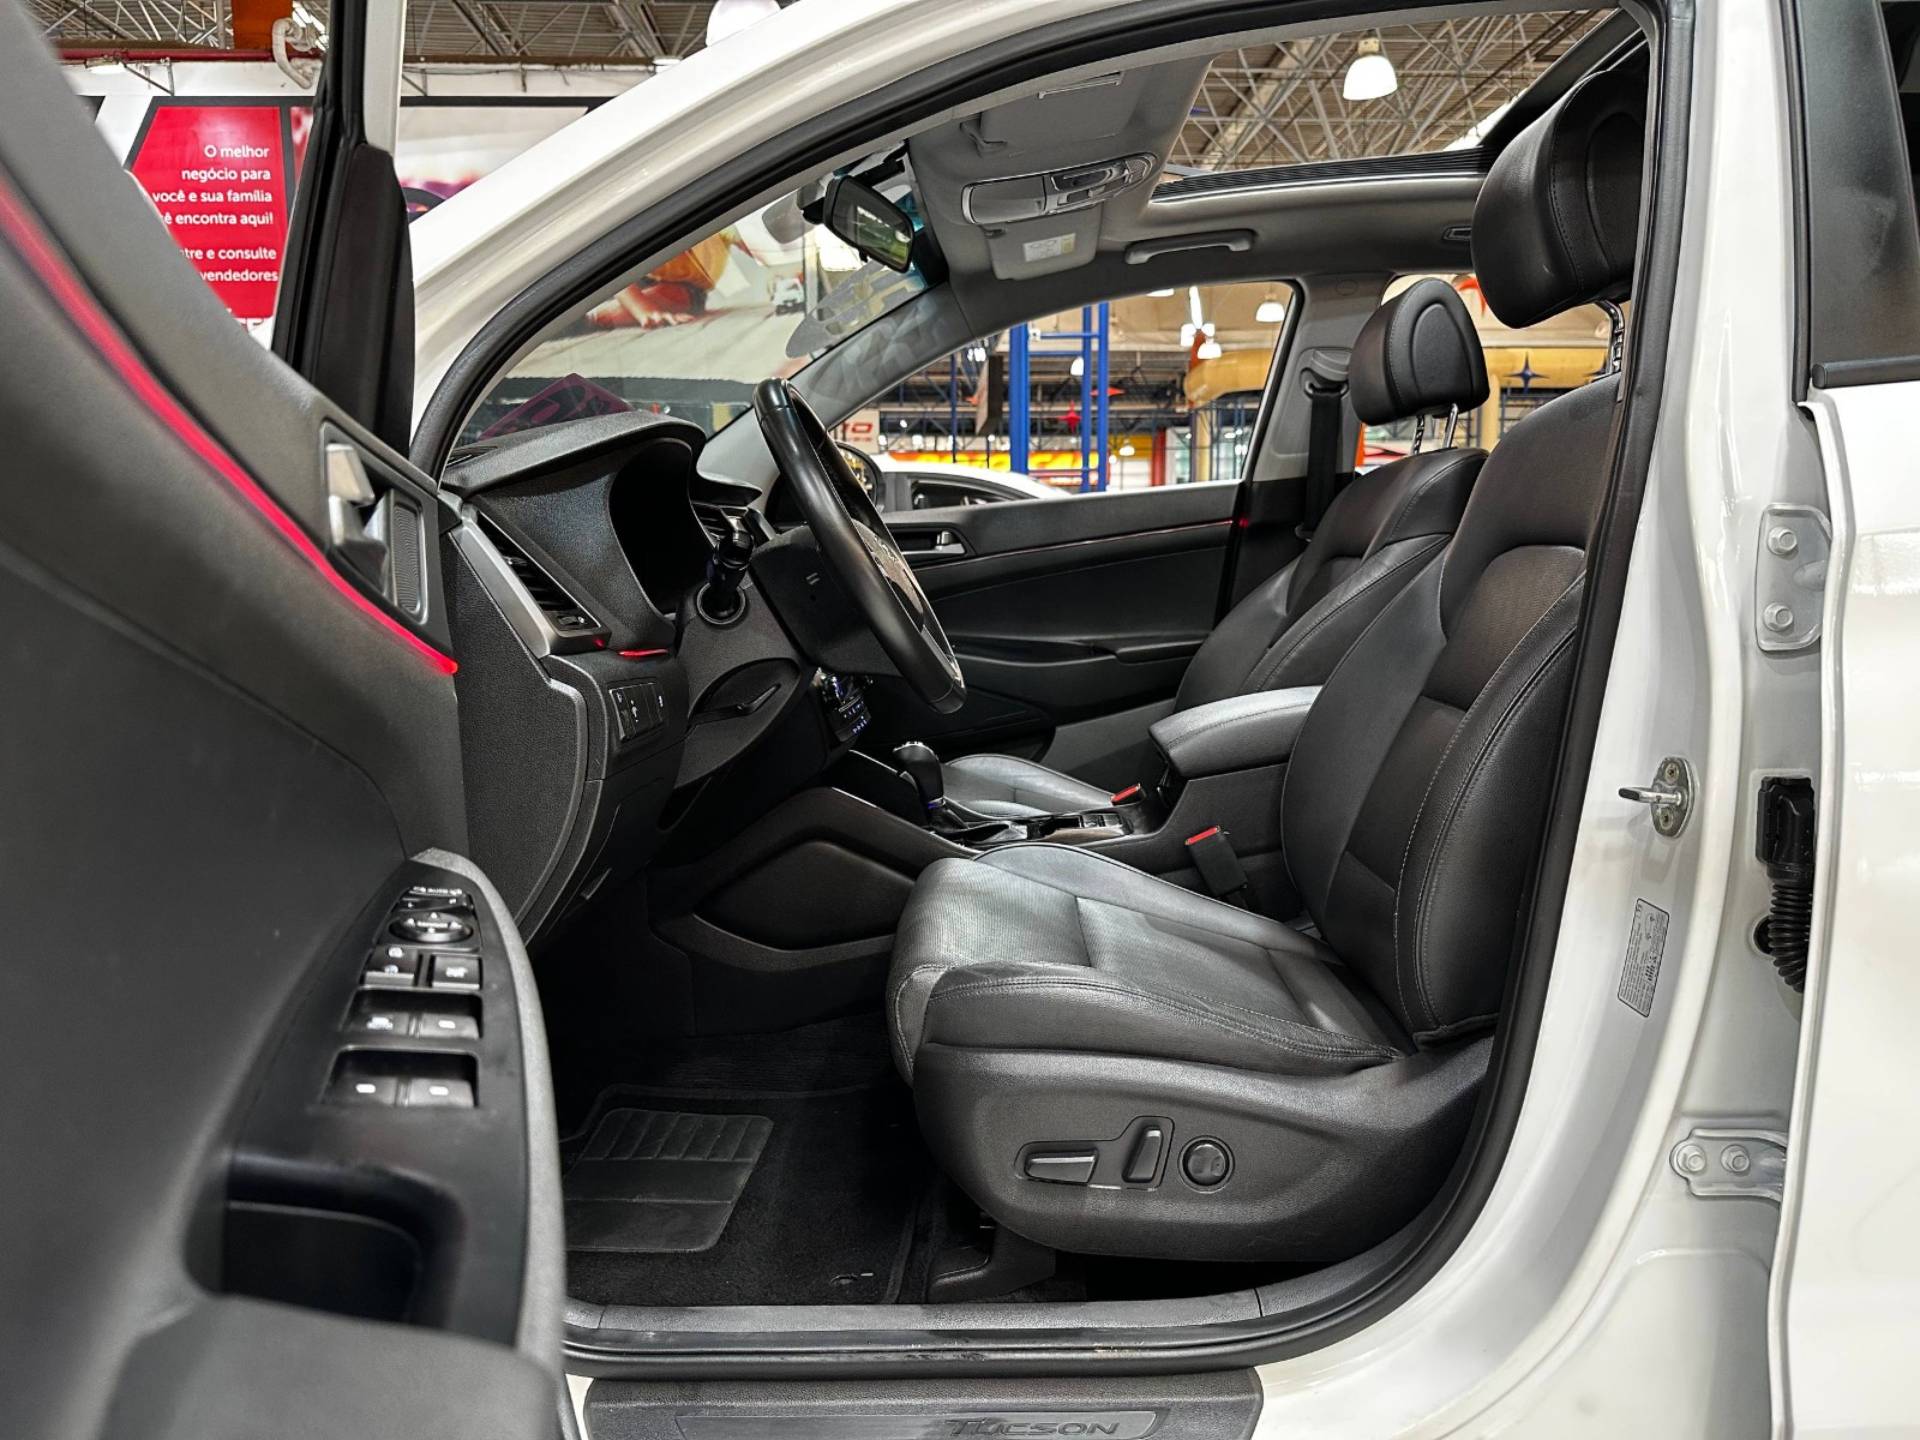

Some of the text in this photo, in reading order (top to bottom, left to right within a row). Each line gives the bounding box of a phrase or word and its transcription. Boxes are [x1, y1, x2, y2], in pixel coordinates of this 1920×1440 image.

[204, 144, 270, 158] O melhor
[181, 167, 271, 182] negócio para
[152, 189, 273, 202] você e sua família
[175, 213, 238, 225] encontra
[240, 211, 273, 227] aqui!
[205, 249, 215, 260] e
[218, 247, 277, 260] consulte
[199, 268, 279, 282] vendedores
[943, 1416, 1121, 1436] TUCSON
